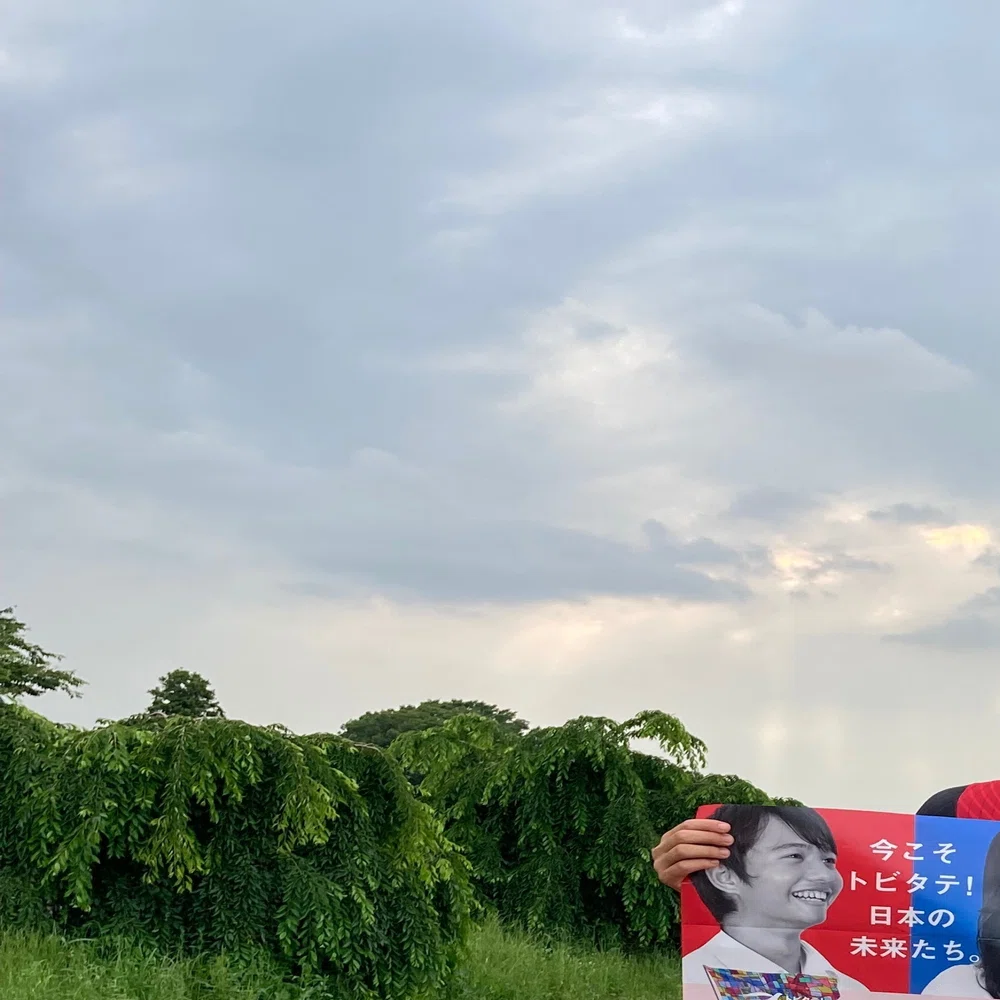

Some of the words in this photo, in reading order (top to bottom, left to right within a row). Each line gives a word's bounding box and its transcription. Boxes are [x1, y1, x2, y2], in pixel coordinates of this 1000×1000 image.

[869, 838, 957, 865] 今こそ
[848, 870, 974, 897] トビタテ!
[869, 907, 954, 928] 日本の
[850, 935, 982, 963] 未来たち。
